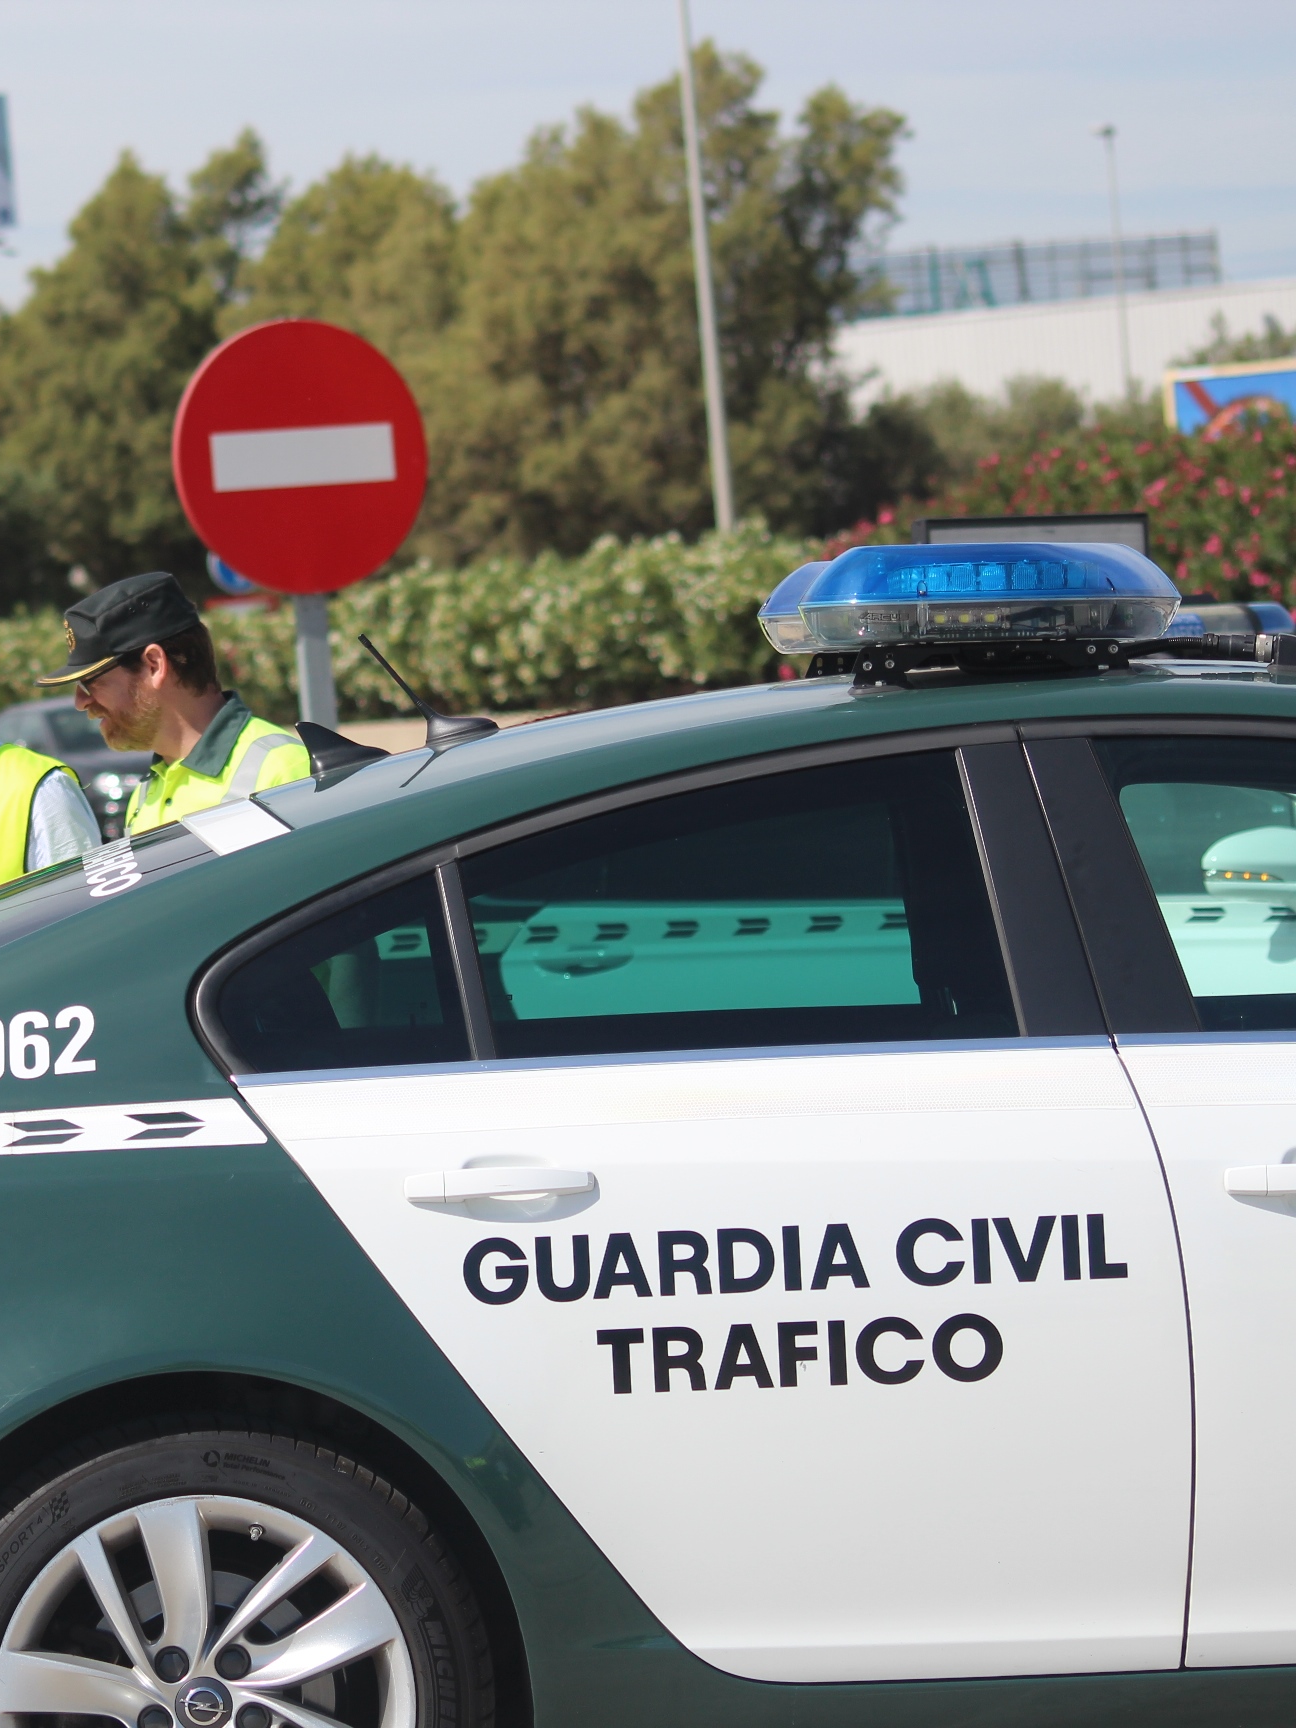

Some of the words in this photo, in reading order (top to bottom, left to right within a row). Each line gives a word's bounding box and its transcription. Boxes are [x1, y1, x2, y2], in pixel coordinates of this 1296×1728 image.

[463, 1223, 870, 1305] GUARDIA
[896, 1213, 1128, 1287] CIVIL
[597, 1313, 1003, 1394] TRAFICO
[223, 1462, 240, 1470] Total
[241, 1464, 286, 1480] Performance
[224, 1452, 270, 1468] MICHELIN
